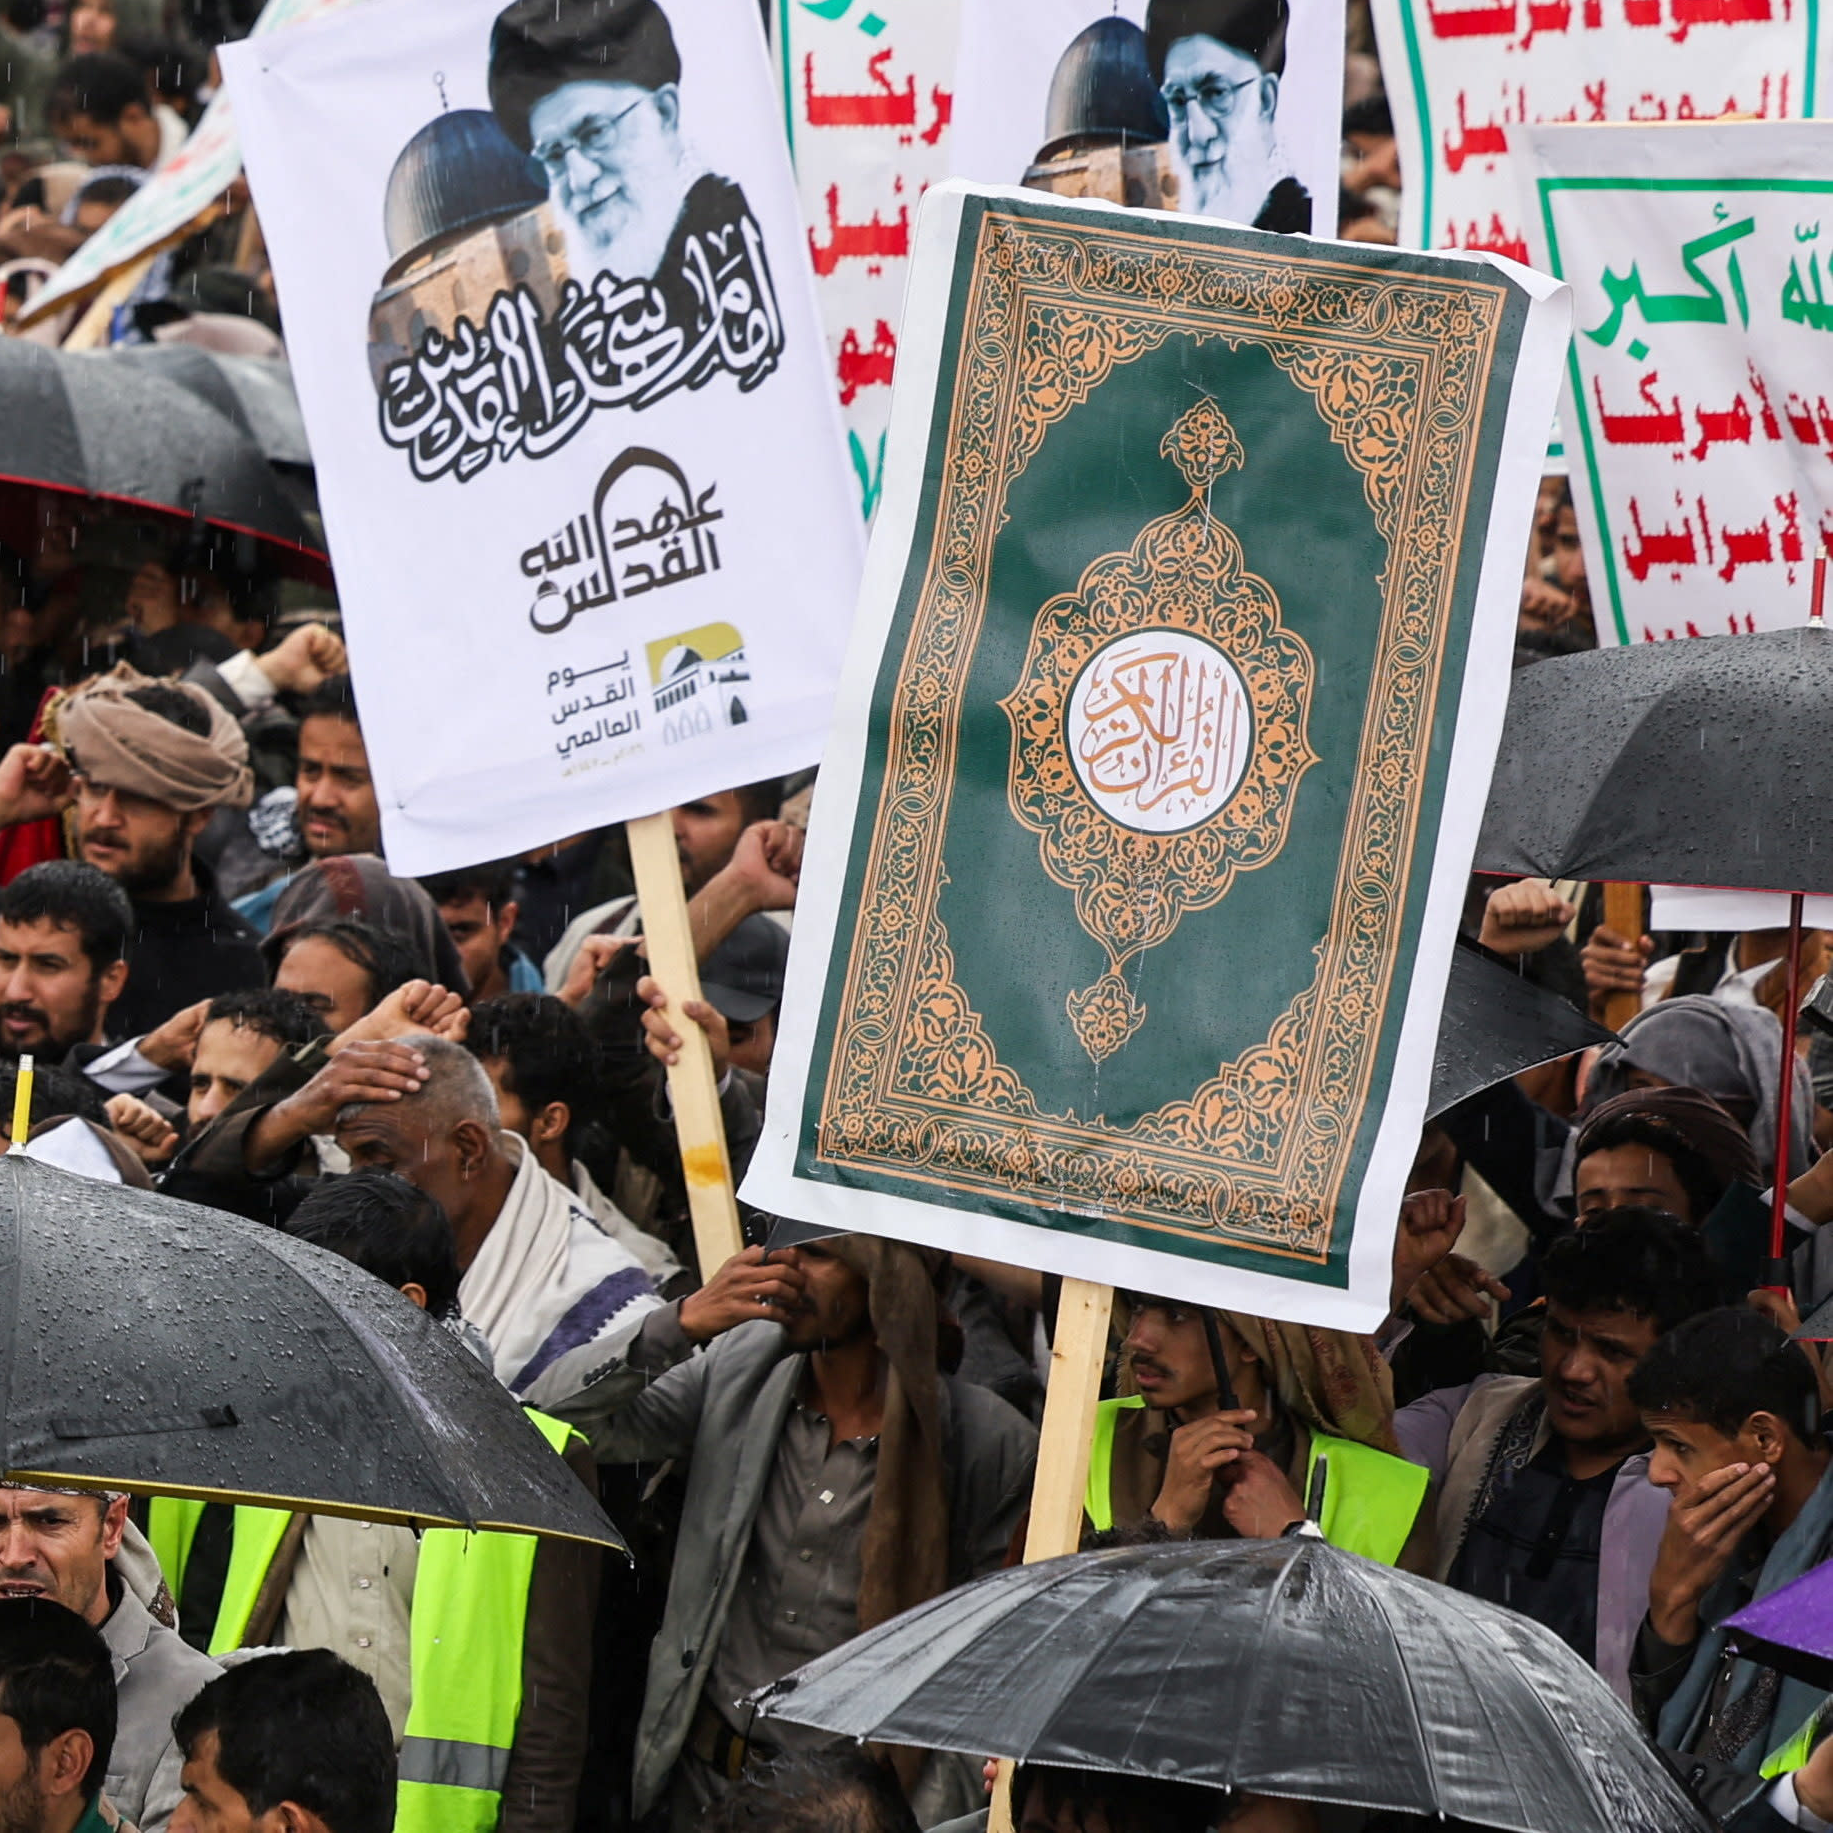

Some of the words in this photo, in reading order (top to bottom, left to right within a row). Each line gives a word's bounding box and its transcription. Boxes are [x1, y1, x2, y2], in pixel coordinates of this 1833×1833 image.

[802, 46, 954, 147] ريكا
[1583, 203, 1756, 361] أكبر
[1593, 362, 1785, 462] لأمريكا
[520, 513, 595, 578] الله
[613, 480, 723, 551] عهد
[1622, 491, 1805, 585] لإسرائيل
[529, 526, 721, 634] القدس
[546, 650, 630, 694] يوم
[552, 677, 635, 724] القدس
[556, 710, 641, 759] العالمي
